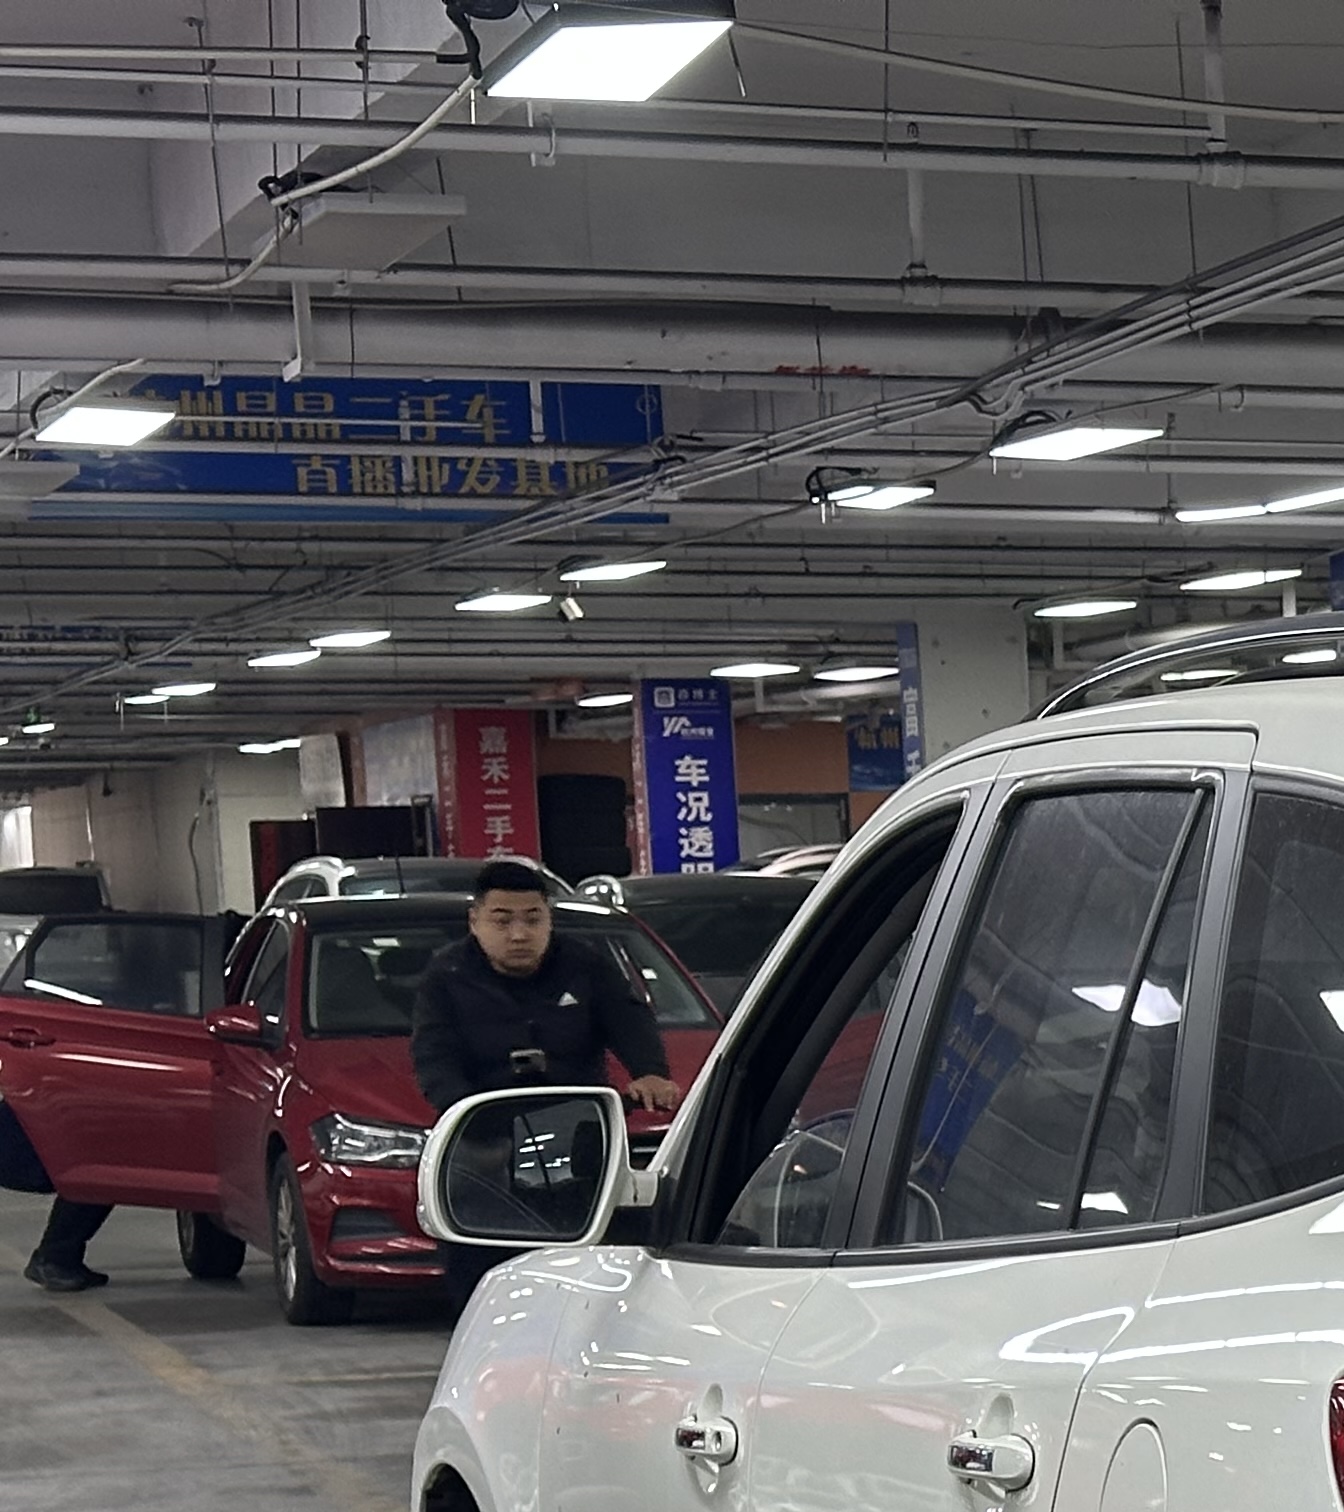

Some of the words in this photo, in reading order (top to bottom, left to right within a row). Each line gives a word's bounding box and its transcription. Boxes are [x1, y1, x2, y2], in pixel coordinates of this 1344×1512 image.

[146, 389, 512, 444] 州晶晶二手车
